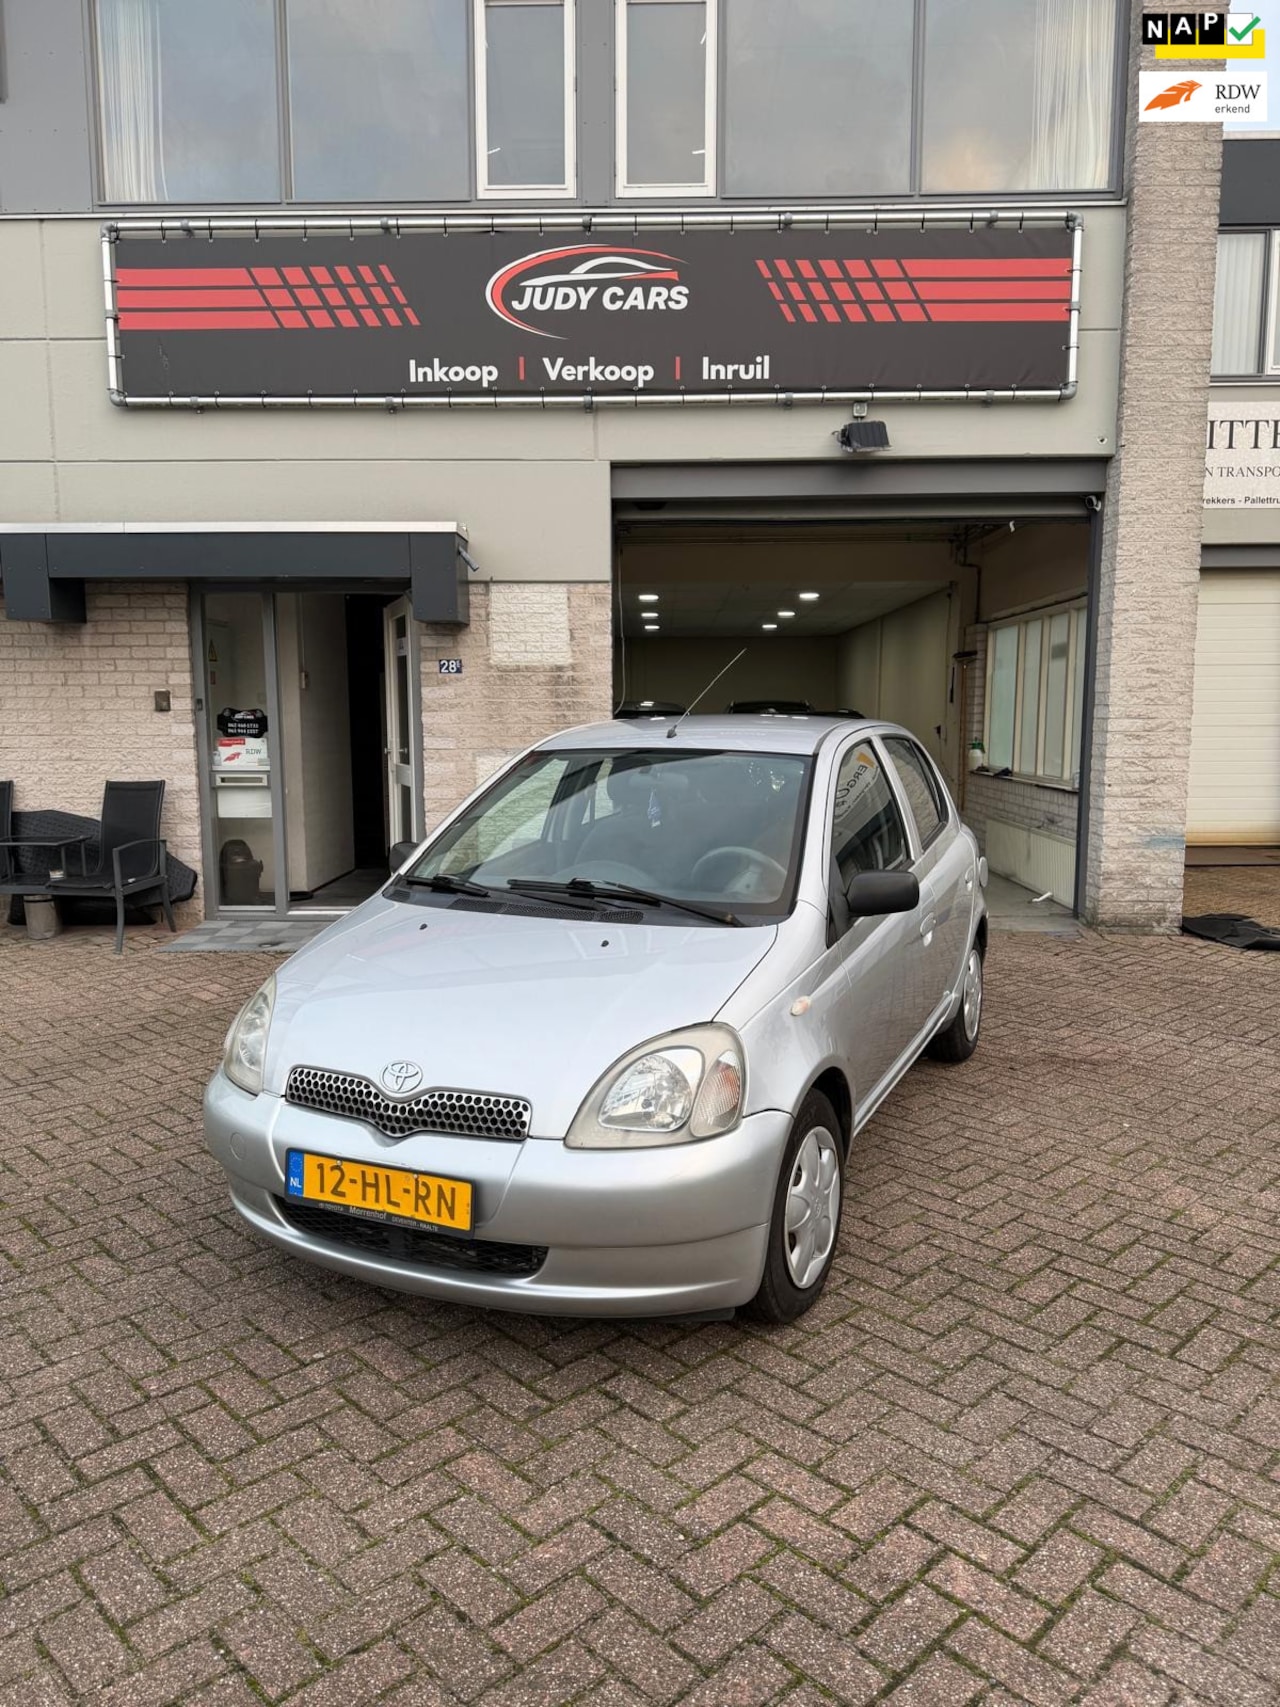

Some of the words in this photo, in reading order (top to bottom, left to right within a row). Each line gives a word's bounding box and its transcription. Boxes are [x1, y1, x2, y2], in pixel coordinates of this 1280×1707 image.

[511, 286, 598, 311] JUDY
[602, 285, 690, 311] CARS
[409, 357, 499, 388] Inkoop
[542, 356, 655, 388] Verkoop
[702, 355, 770, 380] Inruil
[290, 1176, 302, 1188] NL
[316, 1162, 456, 1221] 12-HL-RN
[349, 1205, 387, 1220] Morrenhof
